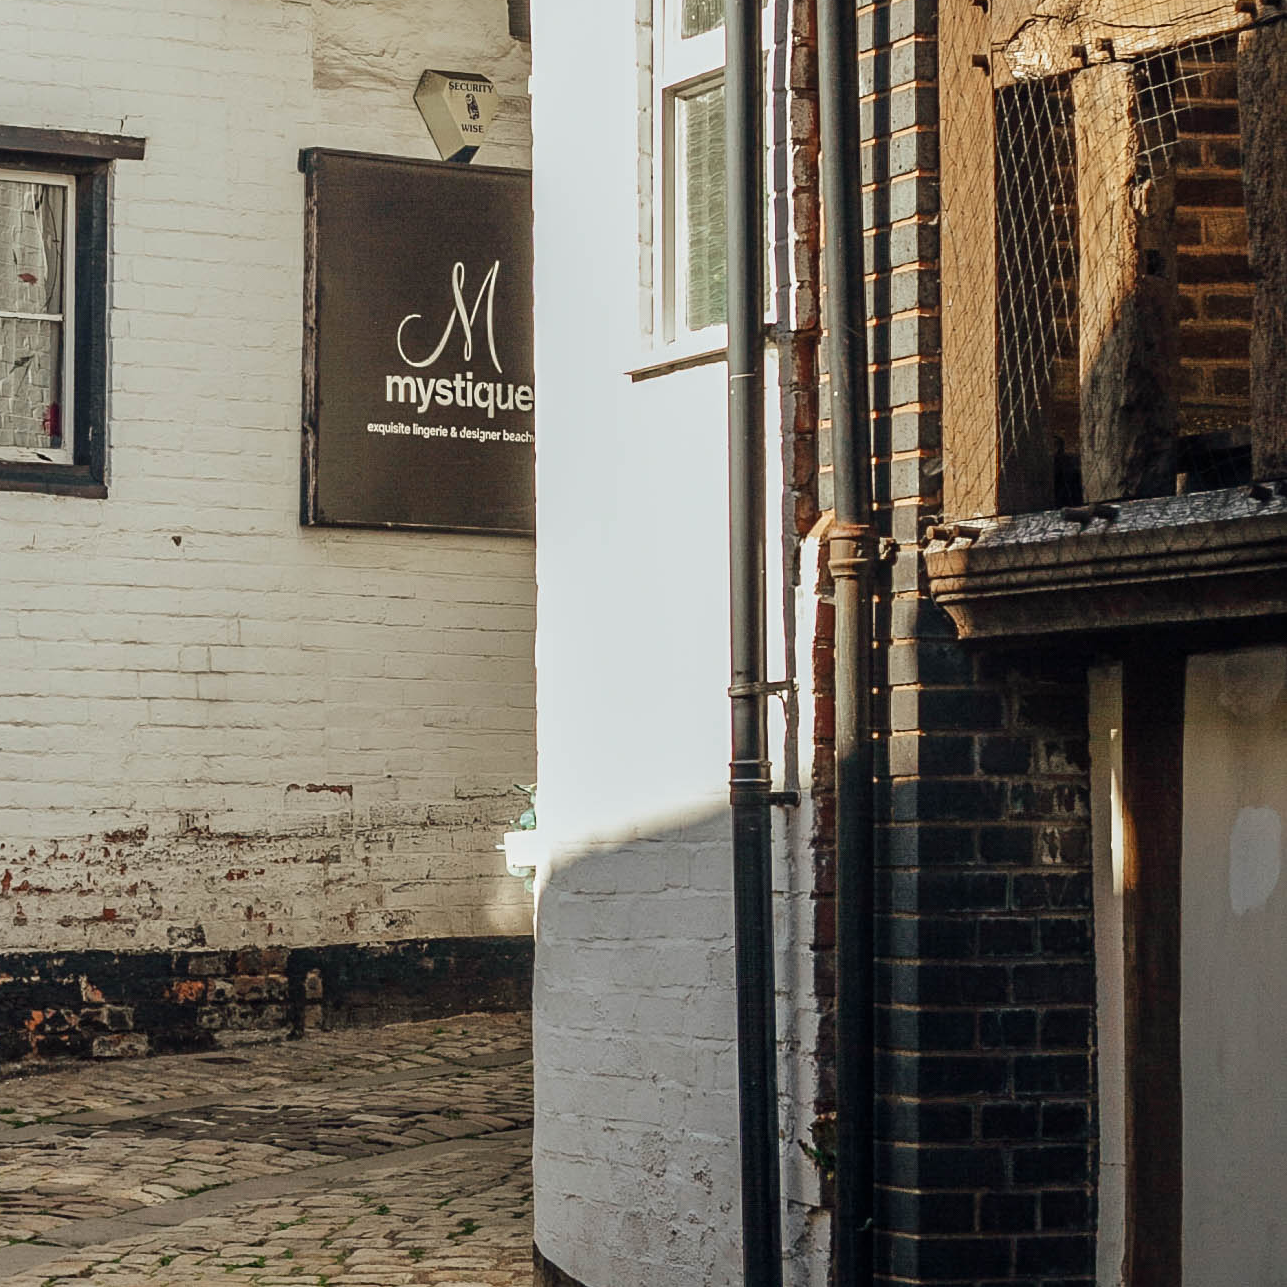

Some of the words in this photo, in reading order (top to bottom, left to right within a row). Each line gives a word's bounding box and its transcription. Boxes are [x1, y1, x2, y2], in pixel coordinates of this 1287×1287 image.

[448, 81, 494, 93] SECURITY
[461, 123, 484, 133] WISE
[397, 260, 502, 374] M
[385, 371, 534, 418] mystique
[367, 422, 411, 435] exquisite
[412, 422, 448, 439] lingerie
[450, 426, 458, 438] &
[459, 426, 501, 442] designer
[502, 429, 535, 443] beach
